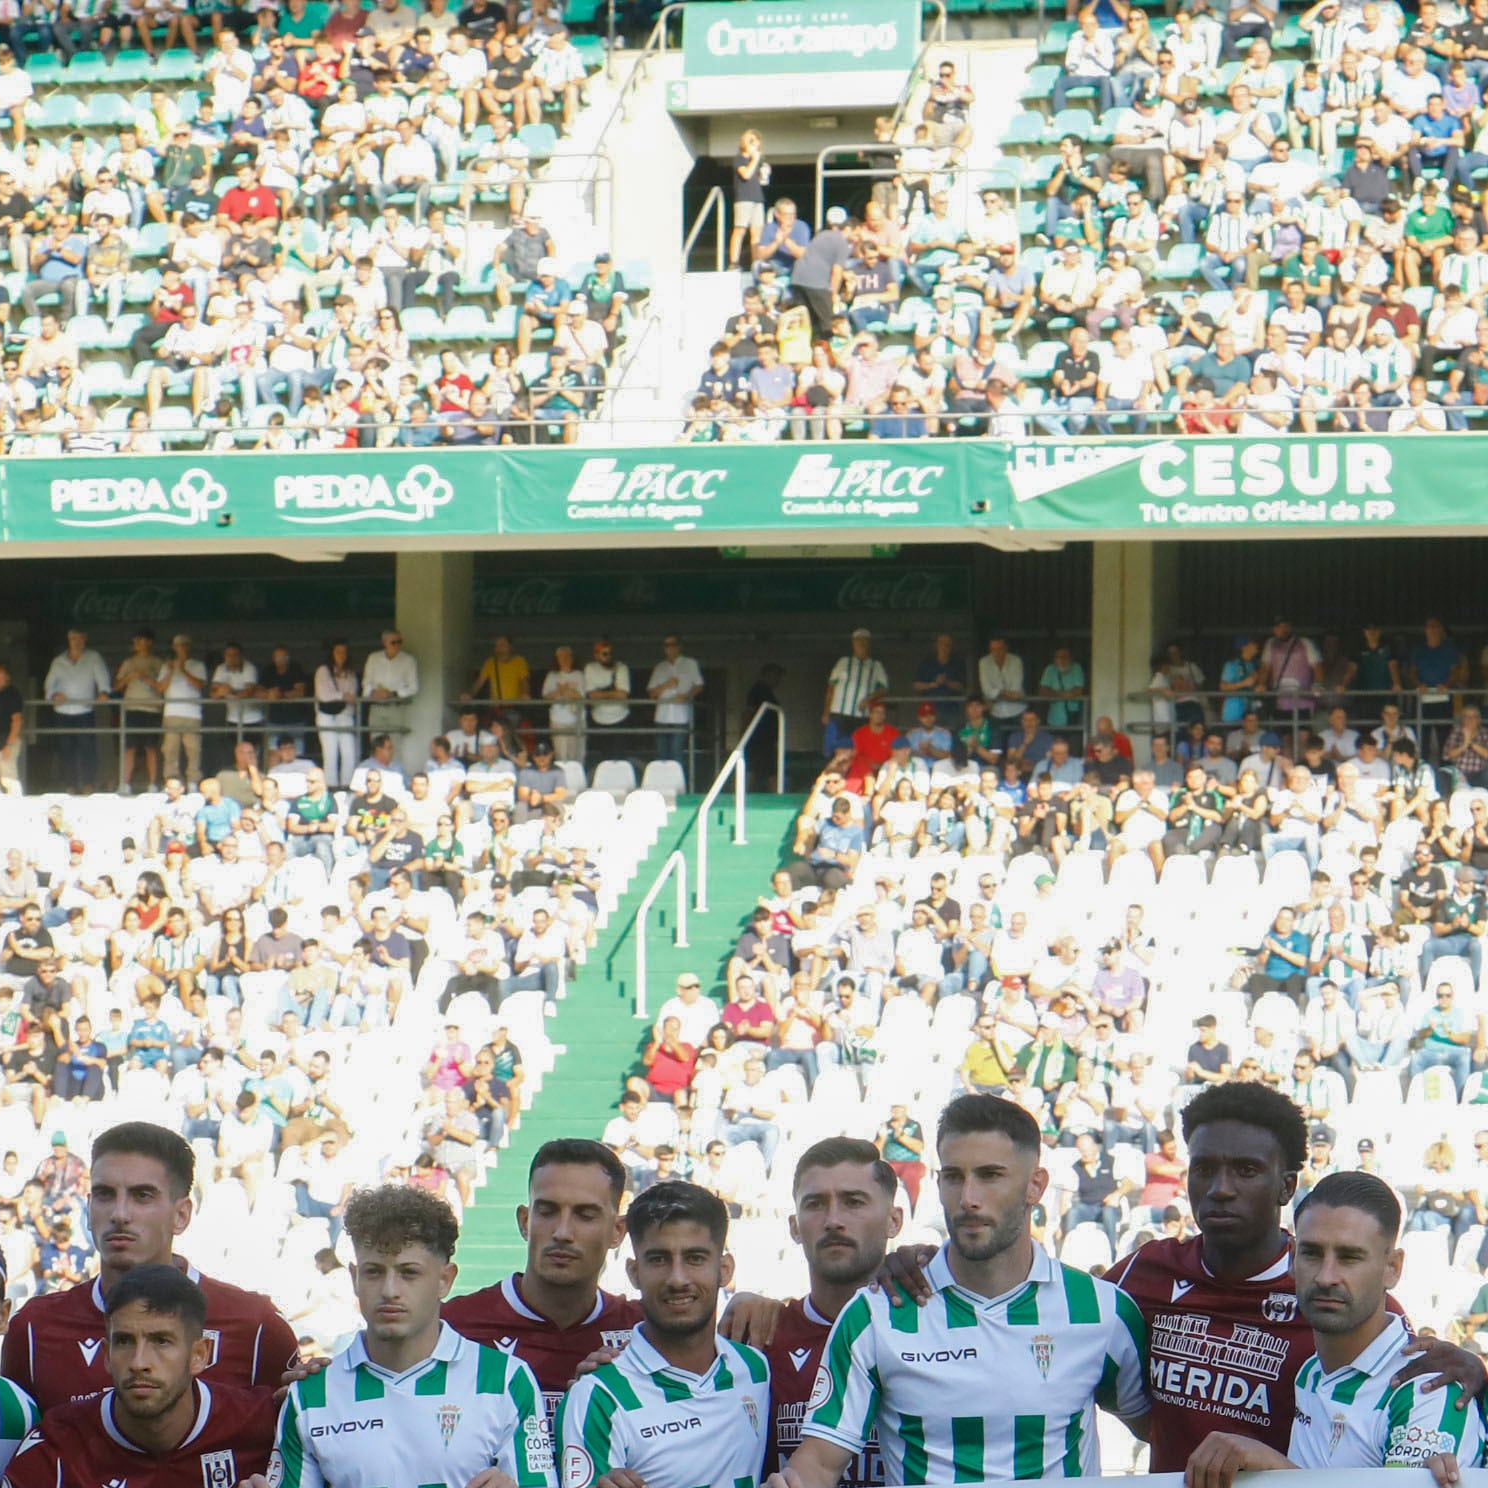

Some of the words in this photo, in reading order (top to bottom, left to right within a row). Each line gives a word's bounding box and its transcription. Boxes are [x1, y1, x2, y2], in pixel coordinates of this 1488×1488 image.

[707, 19, 897, 57] Cruzcampo
[617, 469, 728, 500] PACC
[833, 466, 944, 497] PACC
[1140, 442, 1393, 498] CESUR
[50, 477, 169, 511] PIEDRA
[274, 474, 395, 509] PIEDRA
[1140, 504, 1168, 522] Tu
[1172, 502, 1247, 522] Centro
[1253, 499, 1326, 521] Oficial
[1329, 501, 1359, 521] de
[1364, 500, 1395, 520] FP
[901, 1348, 977, 1362] GIVOVA
[1150, 1357, 1270, 1414] MÉRIDA
[311, 1419, 384, 1437] GIVOVA
[640, 1417, 702, 1438] GIVOVA
[1212, 1404, 1271, 1427] HUMANIDAD
